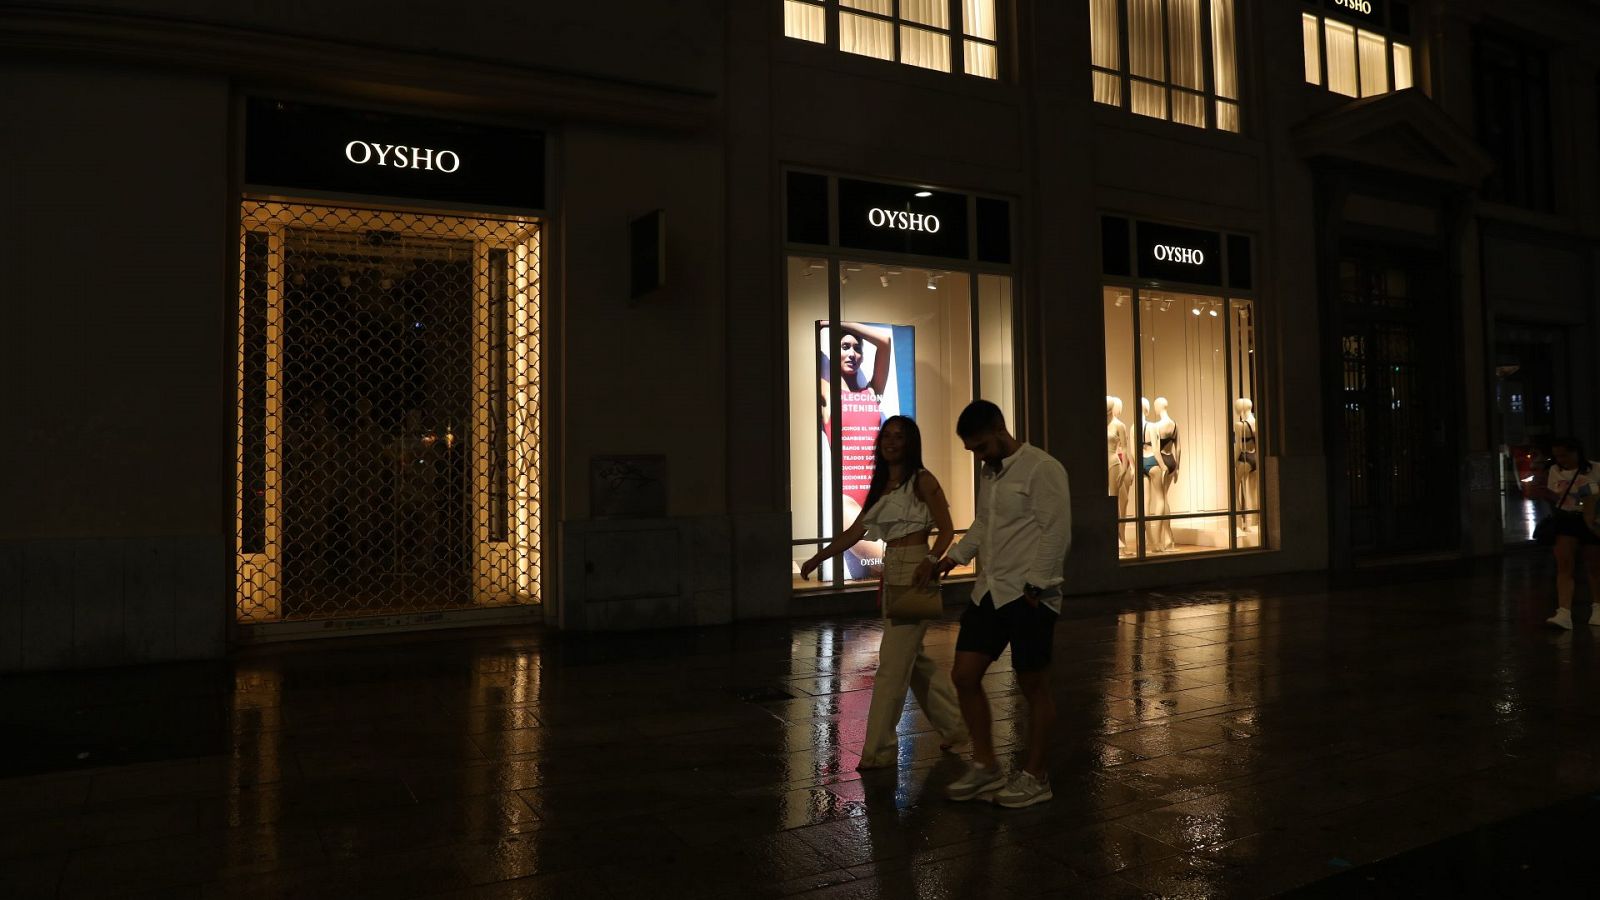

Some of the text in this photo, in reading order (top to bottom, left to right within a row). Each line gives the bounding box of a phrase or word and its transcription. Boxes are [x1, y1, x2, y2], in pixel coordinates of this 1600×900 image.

[345, 140, 460, 173] OYSHO
[868, 207, 940, 233] OYSHO
[1153, 244, 1204, 265] OYSHO
